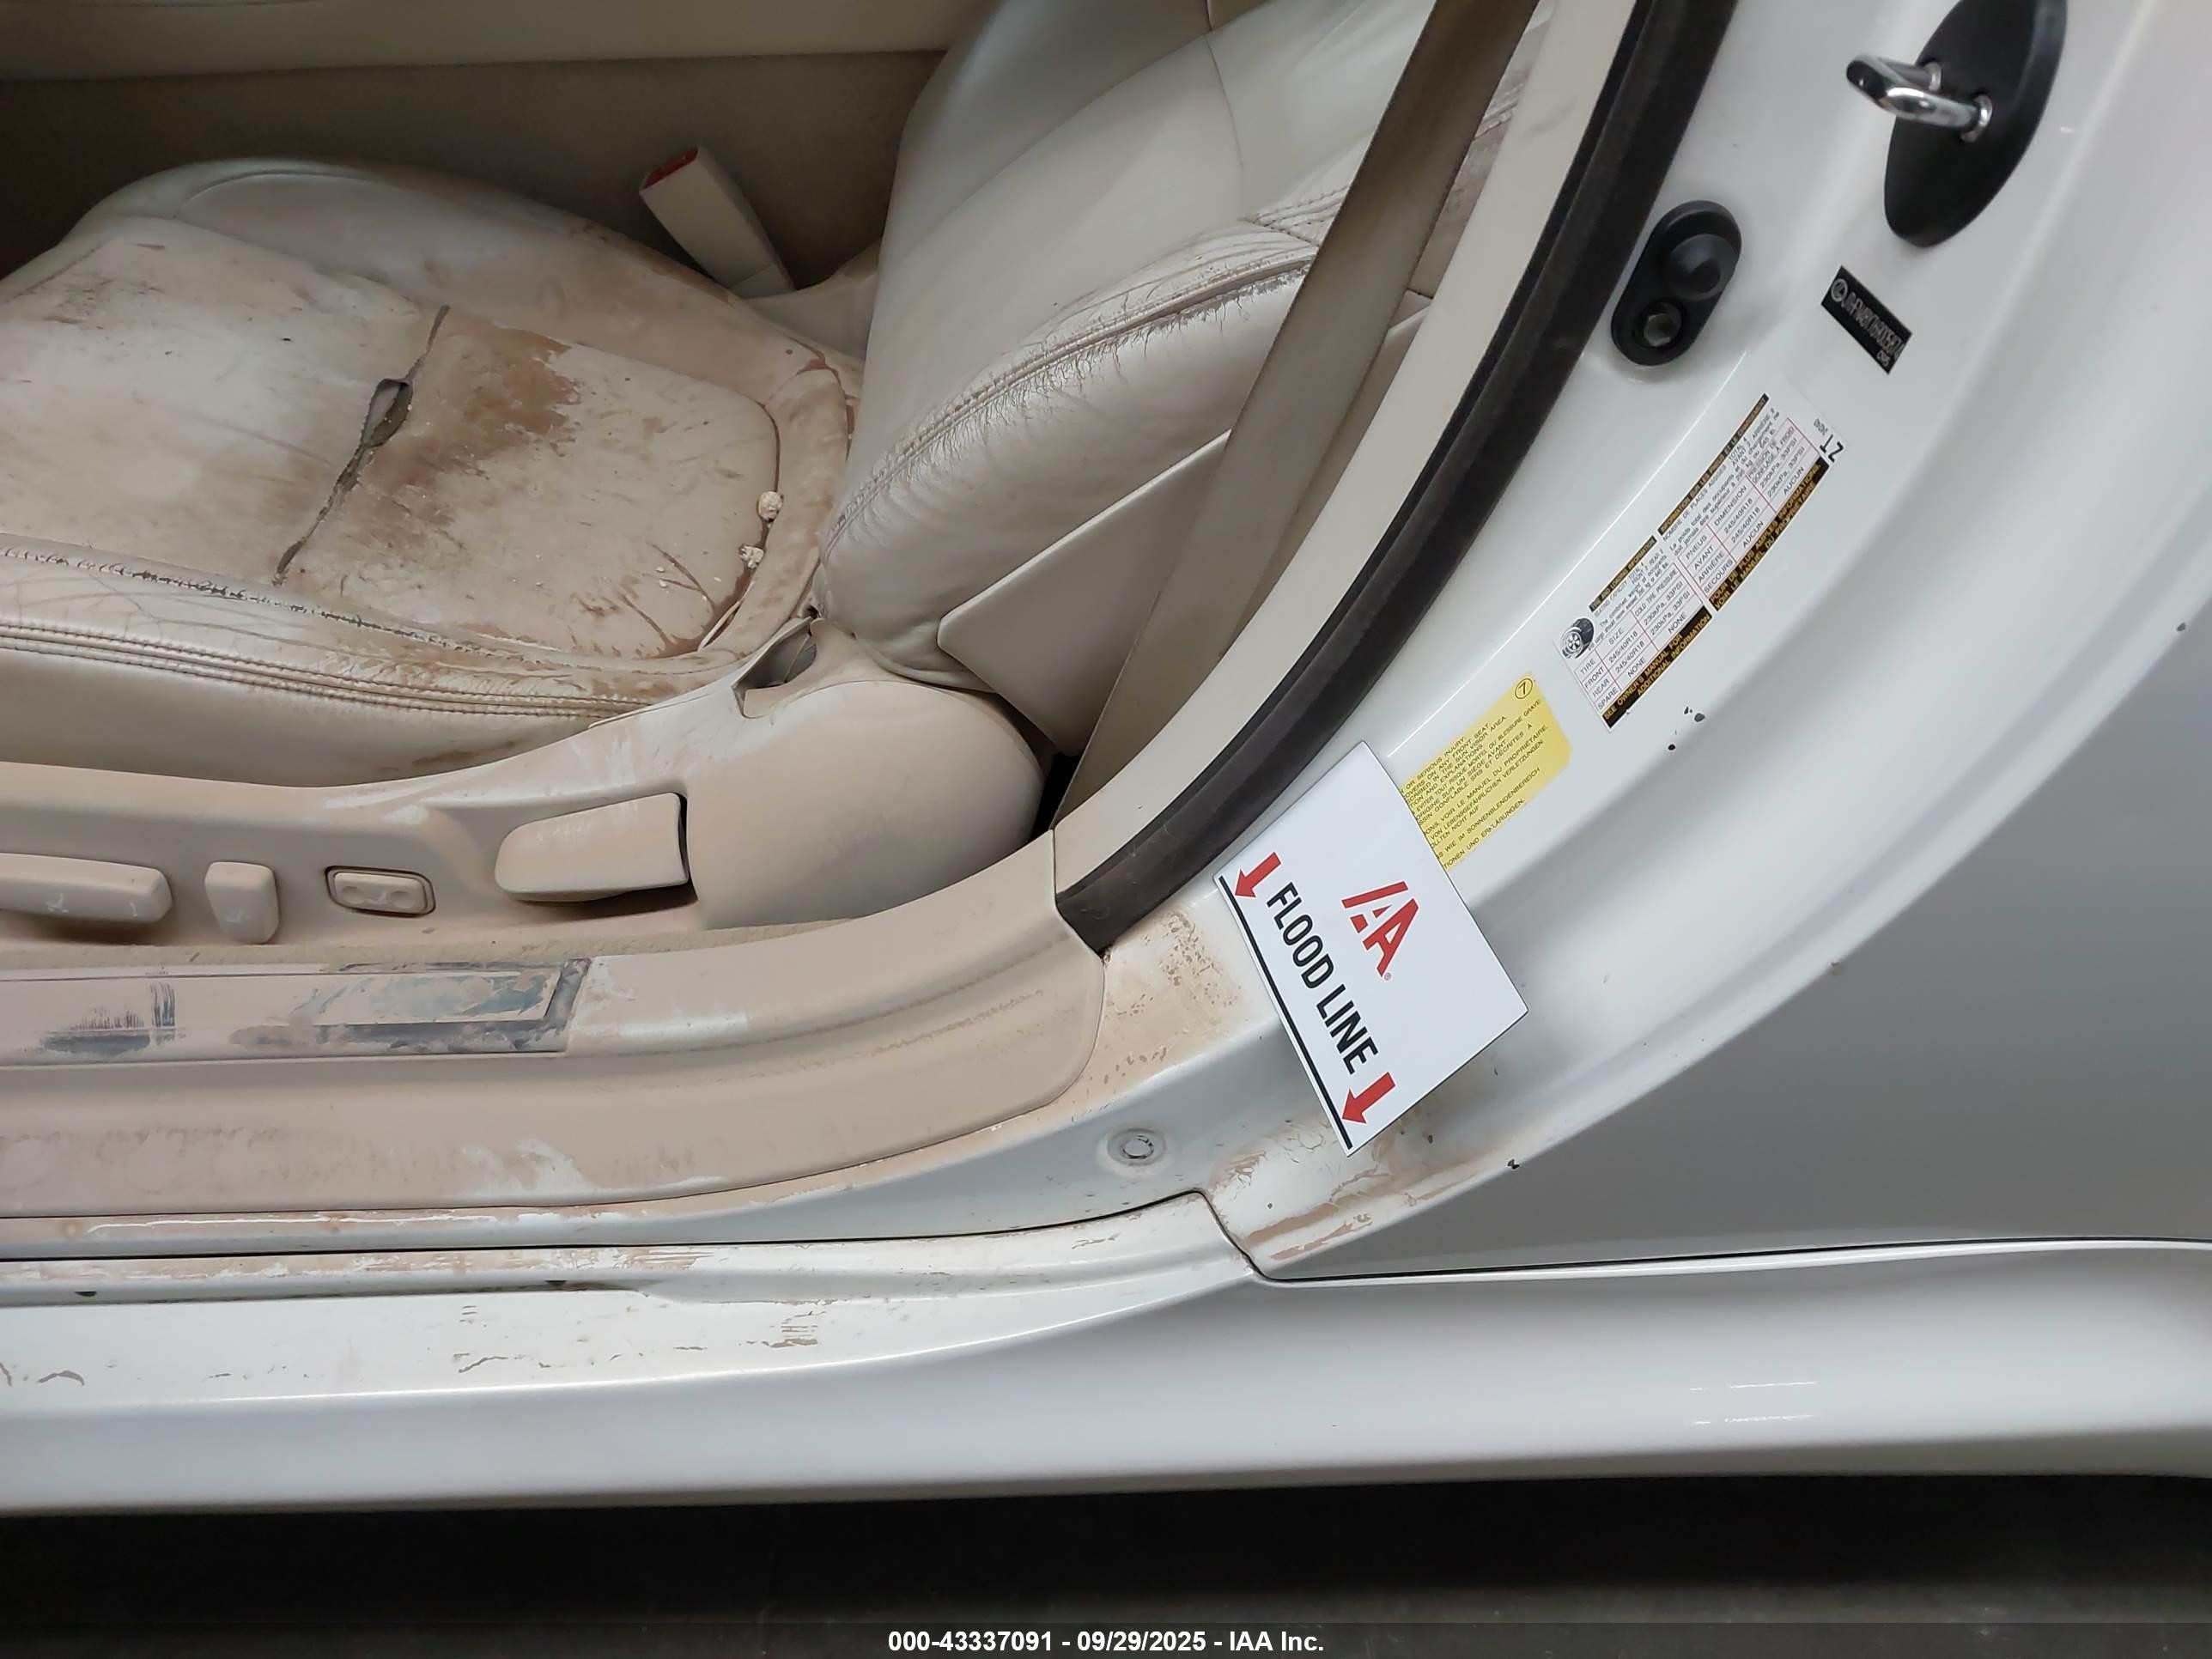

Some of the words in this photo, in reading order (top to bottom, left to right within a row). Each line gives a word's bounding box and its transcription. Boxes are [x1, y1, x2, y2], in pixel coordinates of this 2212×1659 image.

[1782, 465, 1805, 495] AUCUN
[1713, 483, 1747, 527] DIMENSION
[1723, 496, 1753, 534] 245/40R18
[1730, 505, 1760, 544] 245/40R18
[1741, 519, 1764, 549] AUCUN
[1685, 532, 1707, 561] PNEUS
[1692, 544, 1714, 571] AVANT
[1704, 556, 1733, 595] SECOURS
[1607, 626, 1624, 645] SIZE
[1667, 611, 1686, 634] NONE
[1607, 629, 1638, 664] 245/40R18
[1614, 639, 1645, 674] 245/40R18
[1635, 656, 1671, 696] ADDITIONAL
[1669, 613, 1711, 659] INFORMATION
[1580, 658, 1595, 675] TIRE
[1584, 665, 1604, 690] FRONT
[1604, 704, 1617, 720] SEE
[1644, 647, 1668, 677] MANUAL
[1668, 632, 1683, 649] FOR
[1627, 656, 1646, 678] NONE
[1592, 678, 1609, 698] REAR
[1597, 686, 1618, 710] SPARE
[1434, 781, 1448, 797] TOUT
[1448, 766, 1467, 785] RISQUE
[1468, 748, 1487, 768] MORTEL
[1497, 715, 1522, 741] BLESSURE
[1522, 698, 1540, 717] GRAVE
[1441, 761, 1453, 774] THE
[1454, 748, 1468, 763] SUN
[1469, 731, 1488, 750] VISOR
[1488, 714, 1506, 732] AREA
[1402, 778, 1425, 800] OVERS
[1437, 757, 1450, 771] ANY
[1451, 738, 1472, 758] FRONT
[1474, 722, 1489, 738] SEAT
[1416, 756, 1442, 781] SERIOUS
[1441, 785, 1455, 799] SUR
[1486, 738, 1506, 759] AVANT
[1425, 781, 1437, 795] AND
[1430, 827, 1443, 841] VON
[1502, 738, 1543, 779] VERLETZUNGEN
[1433, 779, 1468, 814] GONFLABLE
[1469, 768, 1483, 781] SRS
[1440, 806, 1455, 823] VOIR
[1466, 775, 1492, 800] MANUEL
[1450, 814, 1467, 832] NICHT
[1468, 803, 1480, 817] AUF
[1444, 839, 1456, 853] WIE
[1466, 835, 1480, 851] UND
[1267, 882, 1334, 988] FLOOD
[1316, 984, 1379, 1075] LINE
